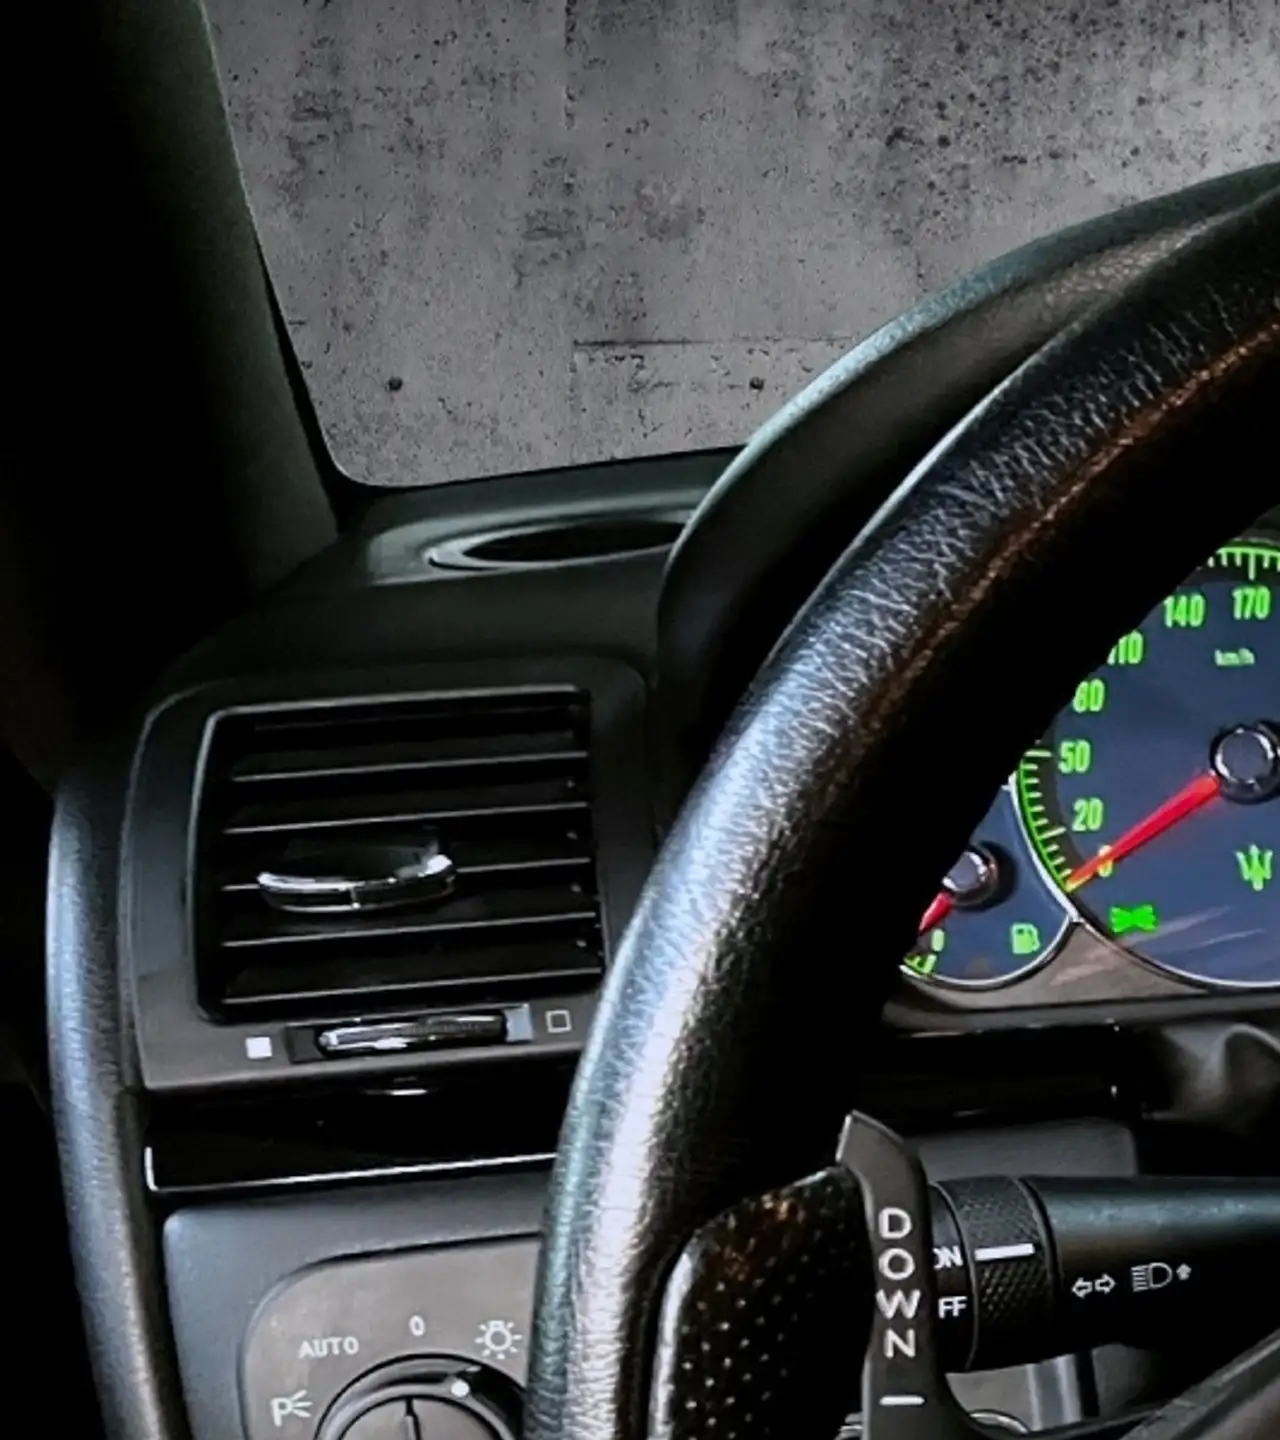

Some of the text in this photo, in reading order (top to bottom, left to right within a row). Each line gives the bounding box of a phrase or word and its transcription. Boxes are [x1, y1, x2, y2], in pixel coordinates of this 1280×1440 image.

[1164, 593, 1205, 628] 140
[1232, 586, 1270, 620] 170
[1058, 738, 1091, 774] 50
[1071, 797, 1104, 832] 20
[875, 1206, 922, 1359] DOWN
[938, 1295, 968, 1319] FF
[299, 1336, 360, 1358] AUTO
